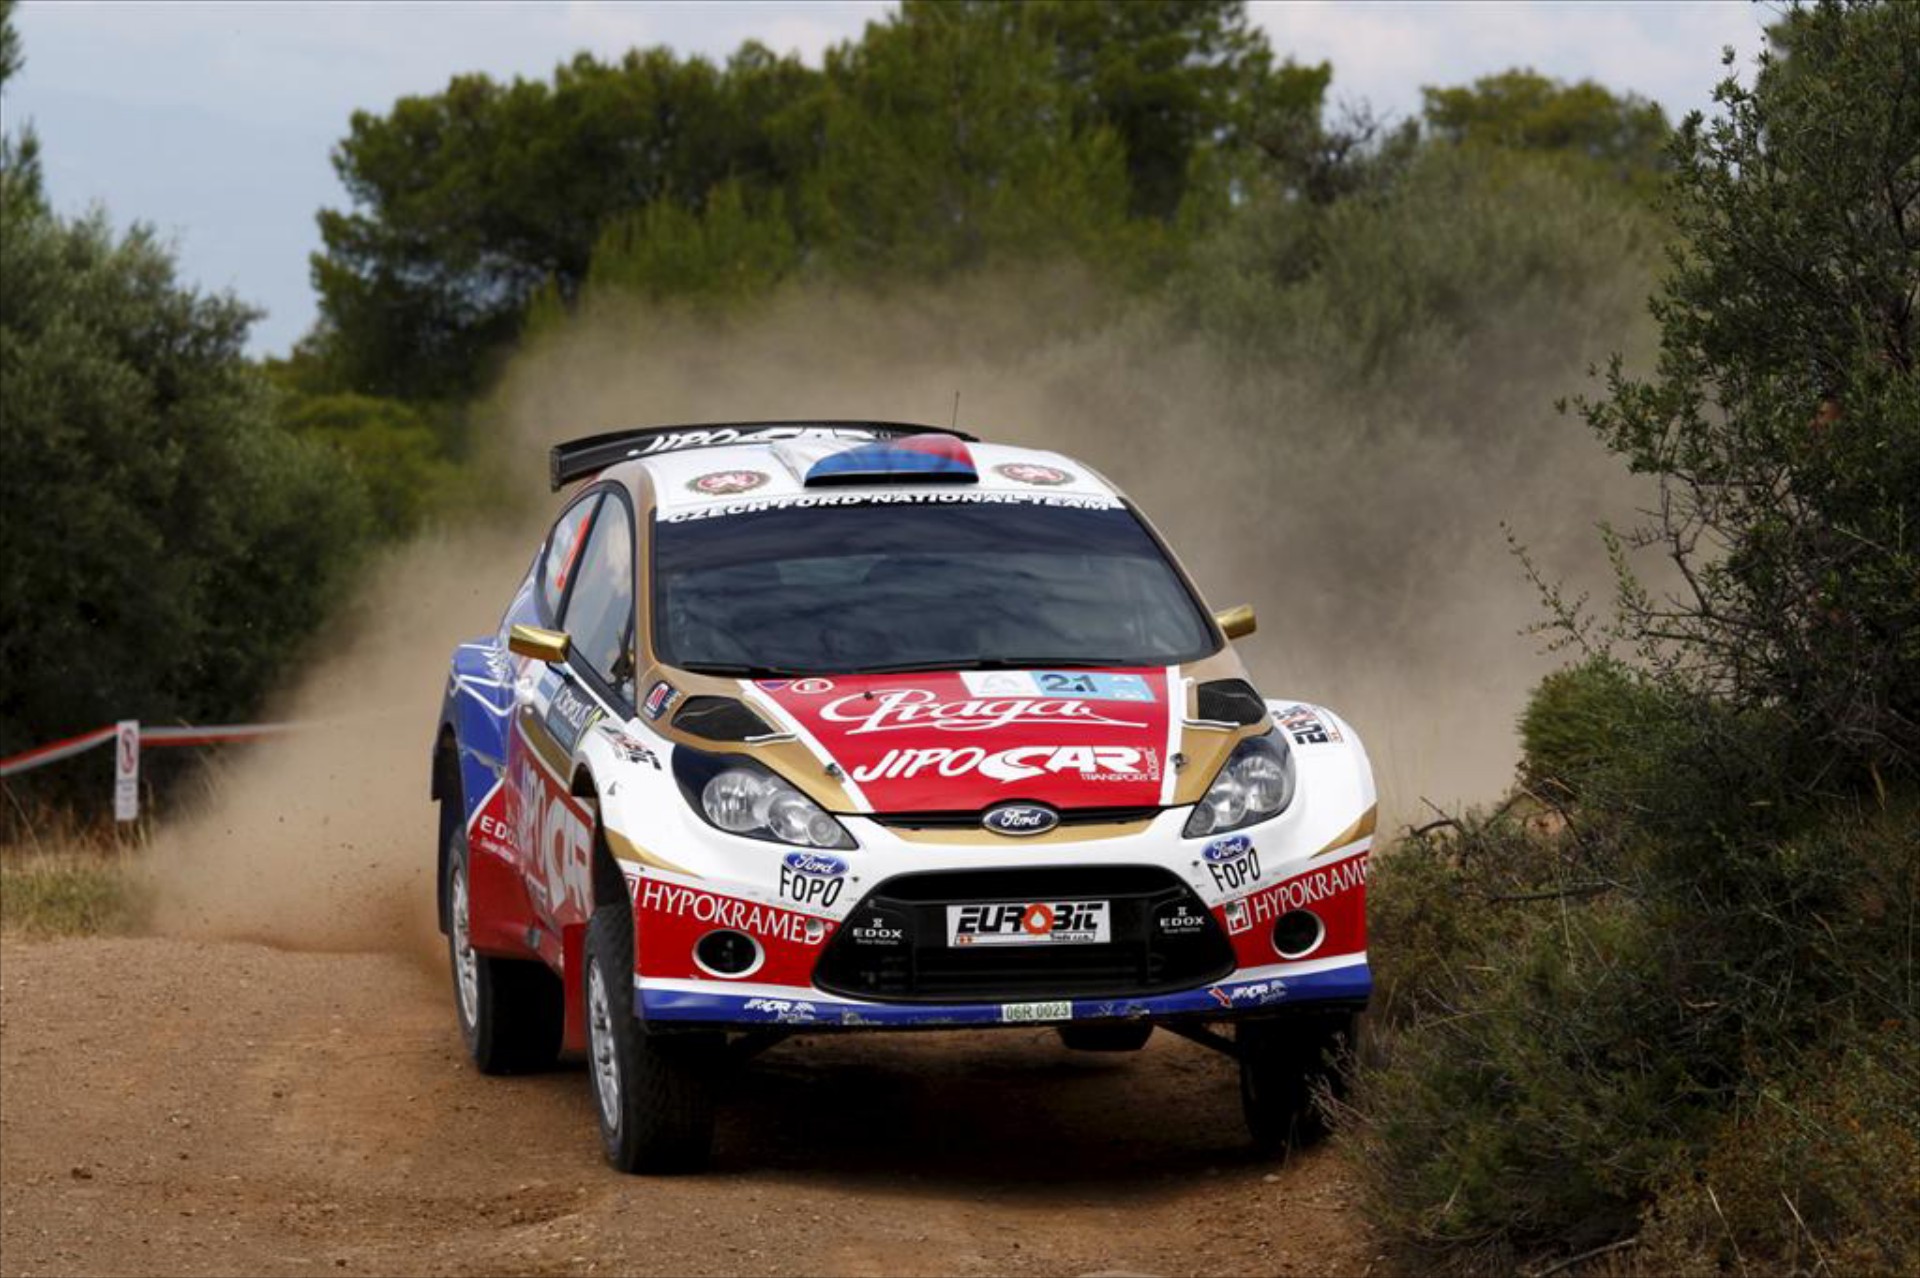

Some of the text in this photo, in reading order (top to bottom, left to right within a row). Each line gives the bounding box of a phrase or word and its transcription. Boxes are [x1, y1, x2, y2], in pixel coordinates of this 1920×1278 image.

[667, 492, 1111, 524] CZECH FORD NATIONAL TEAM
[1041, 673, 1099, 693] 21
[819, 689, 1148, 735] Praga
[1000, 807, 1042, 828] Ford
[1207, 847, 1261, 892] FOPO
[779, 864, 844, 908] FOPO
[853, 927, 903, 939] EDOX
[1160, 916, 1204, 927] EDOX
